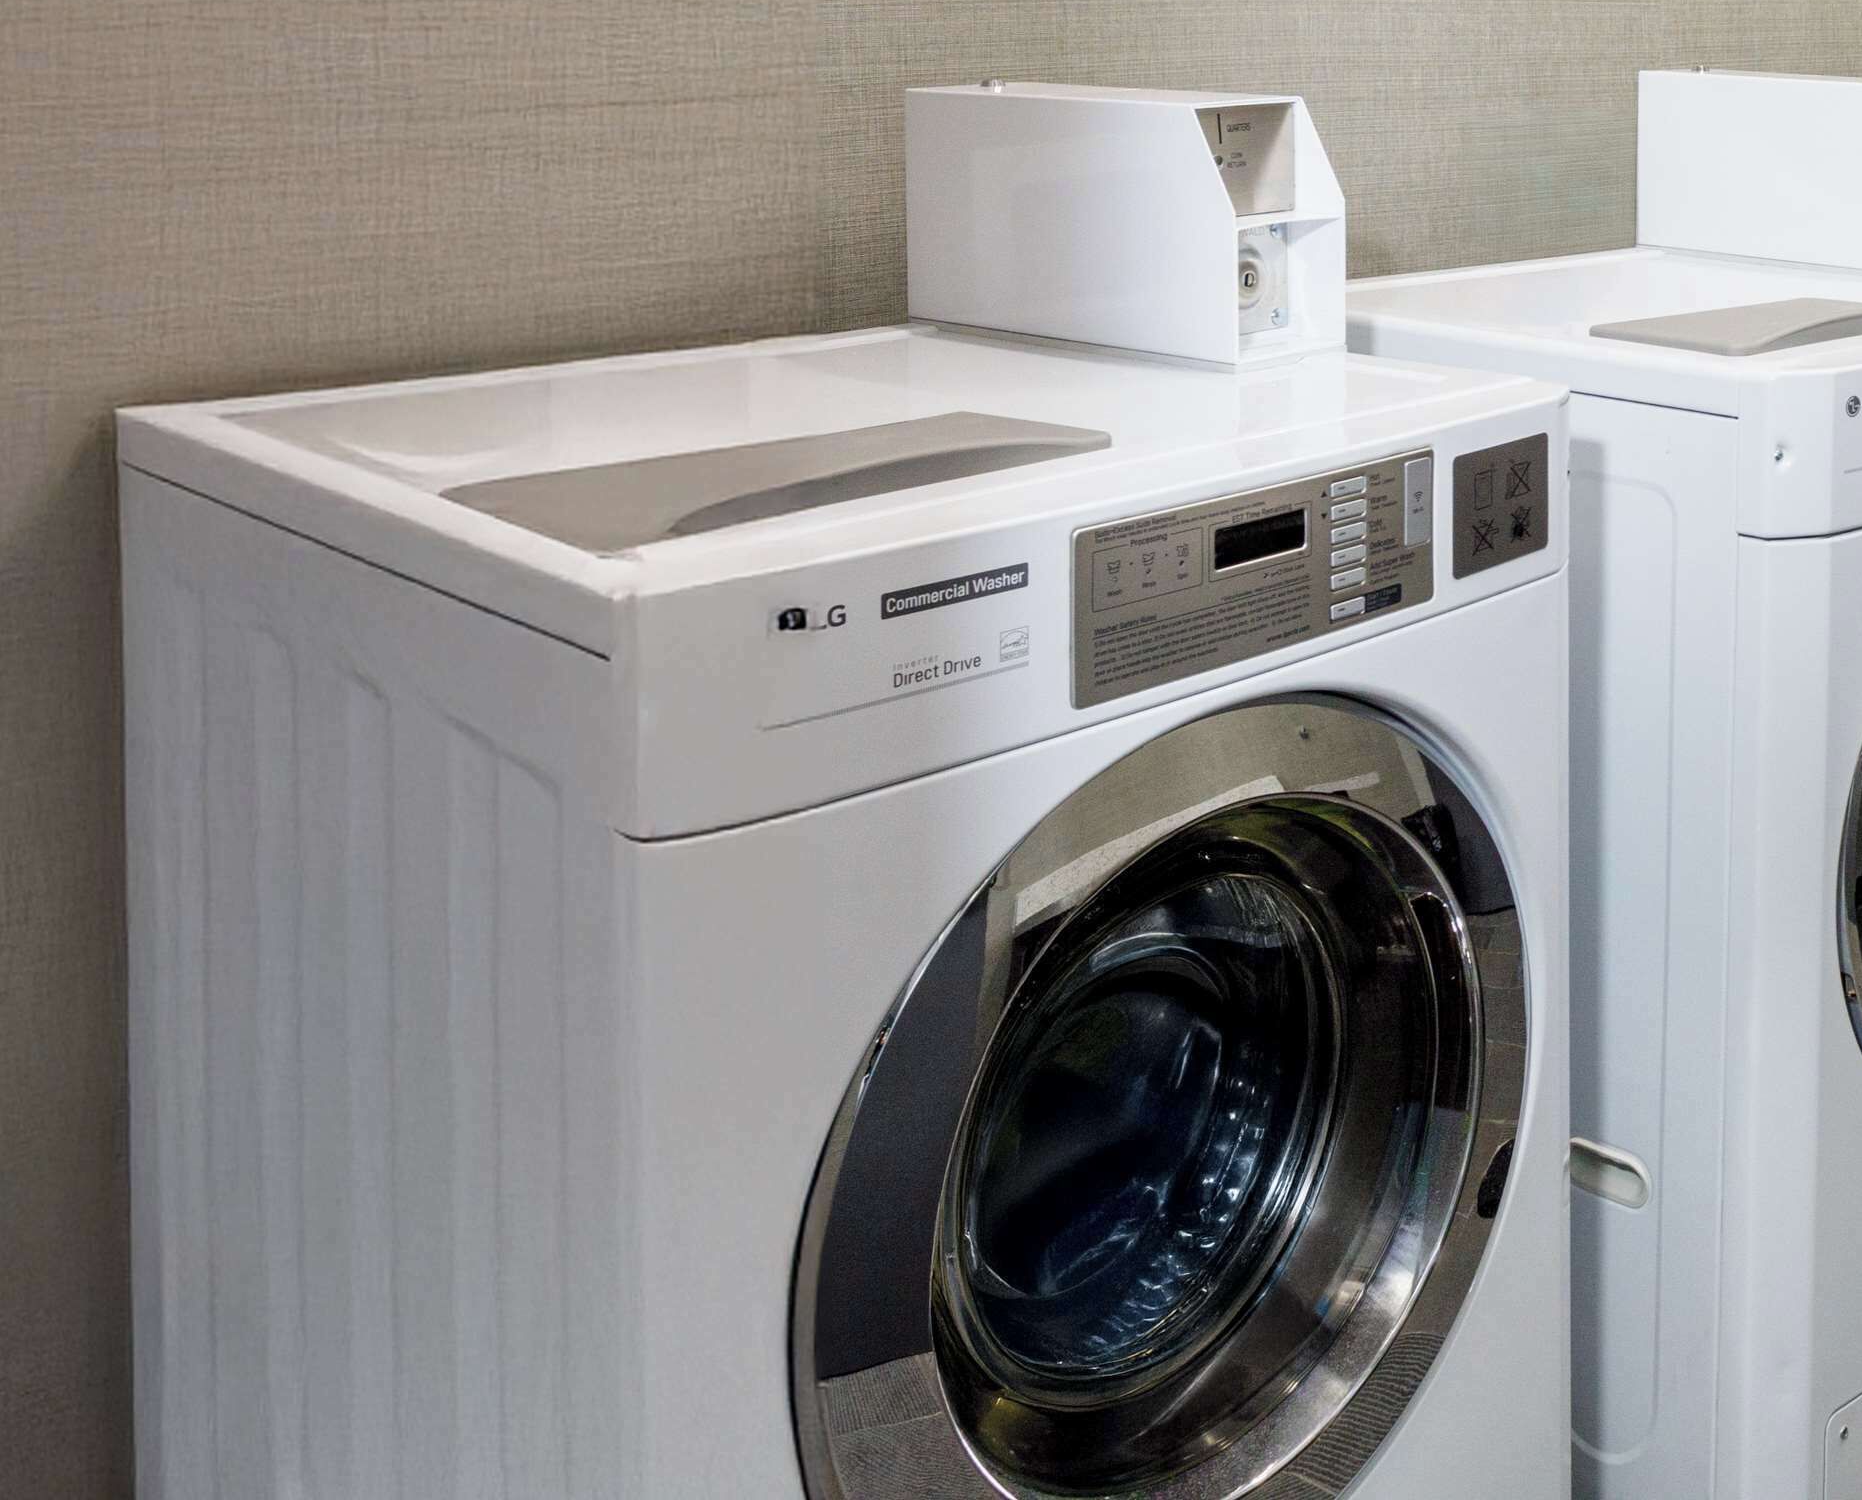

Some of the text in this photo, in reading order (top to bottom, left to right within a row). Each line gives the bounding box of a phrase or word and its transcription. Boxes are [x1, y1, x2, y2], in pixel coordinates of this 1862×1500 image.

[886, 571, 1025, 613] Commercial Washer
[893, 664, 940, 689] Direct
[943, 655, 982, 676] Drive
